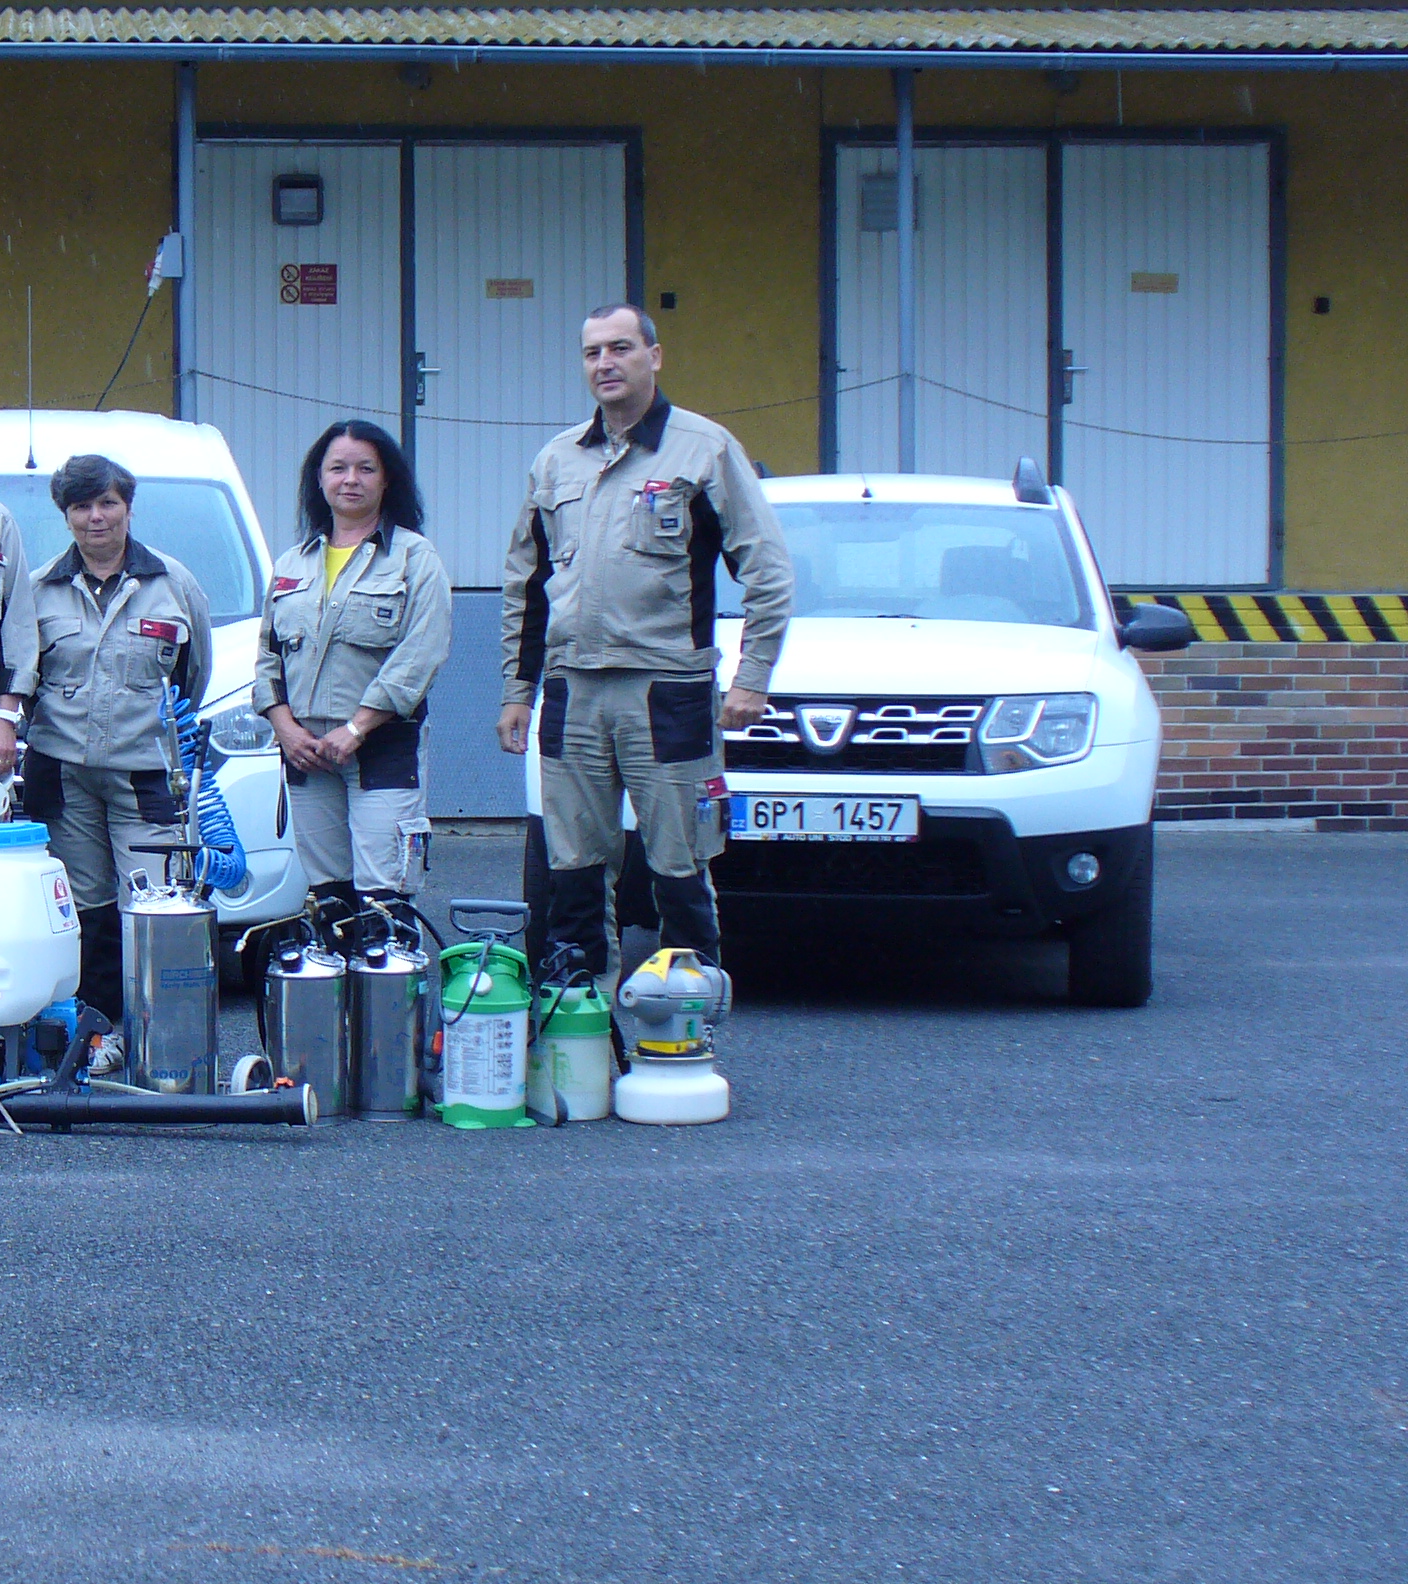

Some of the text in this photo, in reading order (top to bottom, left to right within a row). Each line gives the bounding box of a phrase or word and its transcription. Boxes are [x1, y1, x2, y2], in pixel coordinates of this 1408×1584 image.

[731, 818, 746, 828] CZ
[754, 801, 903, 831] 6P1 1457
